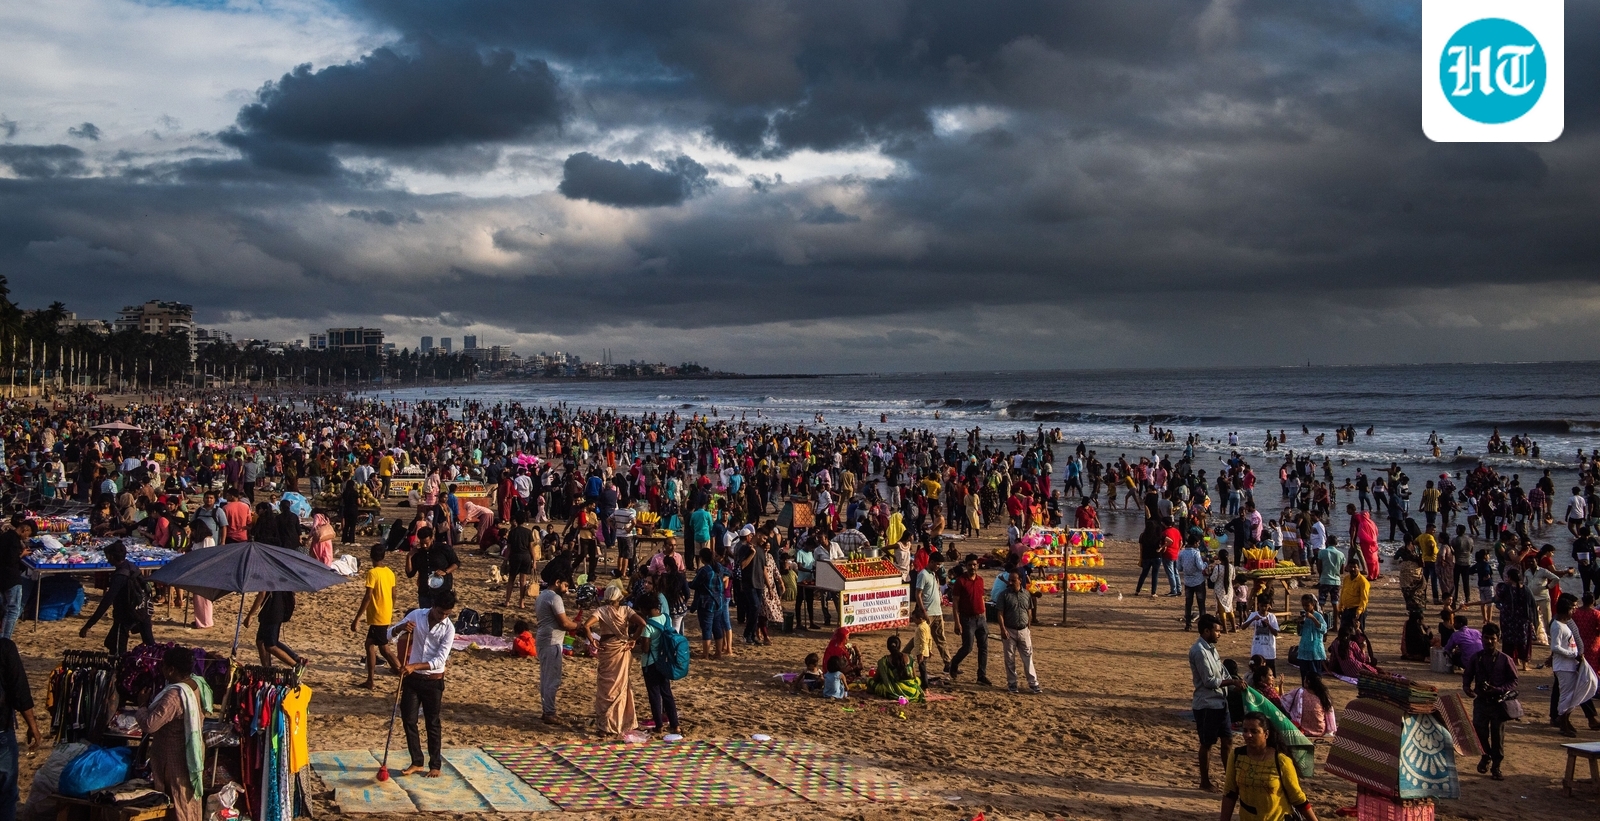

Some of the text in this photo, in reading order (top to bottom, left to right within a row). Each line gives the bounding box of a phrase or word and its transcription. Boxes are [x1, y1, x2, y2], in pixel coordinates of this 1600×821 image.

[851, 594, 857, 602] OM
[866, 592, 875, 600] RAM
[876, 591, 890, 599] CHANA
[890, 589, 907, 597] MASALA
